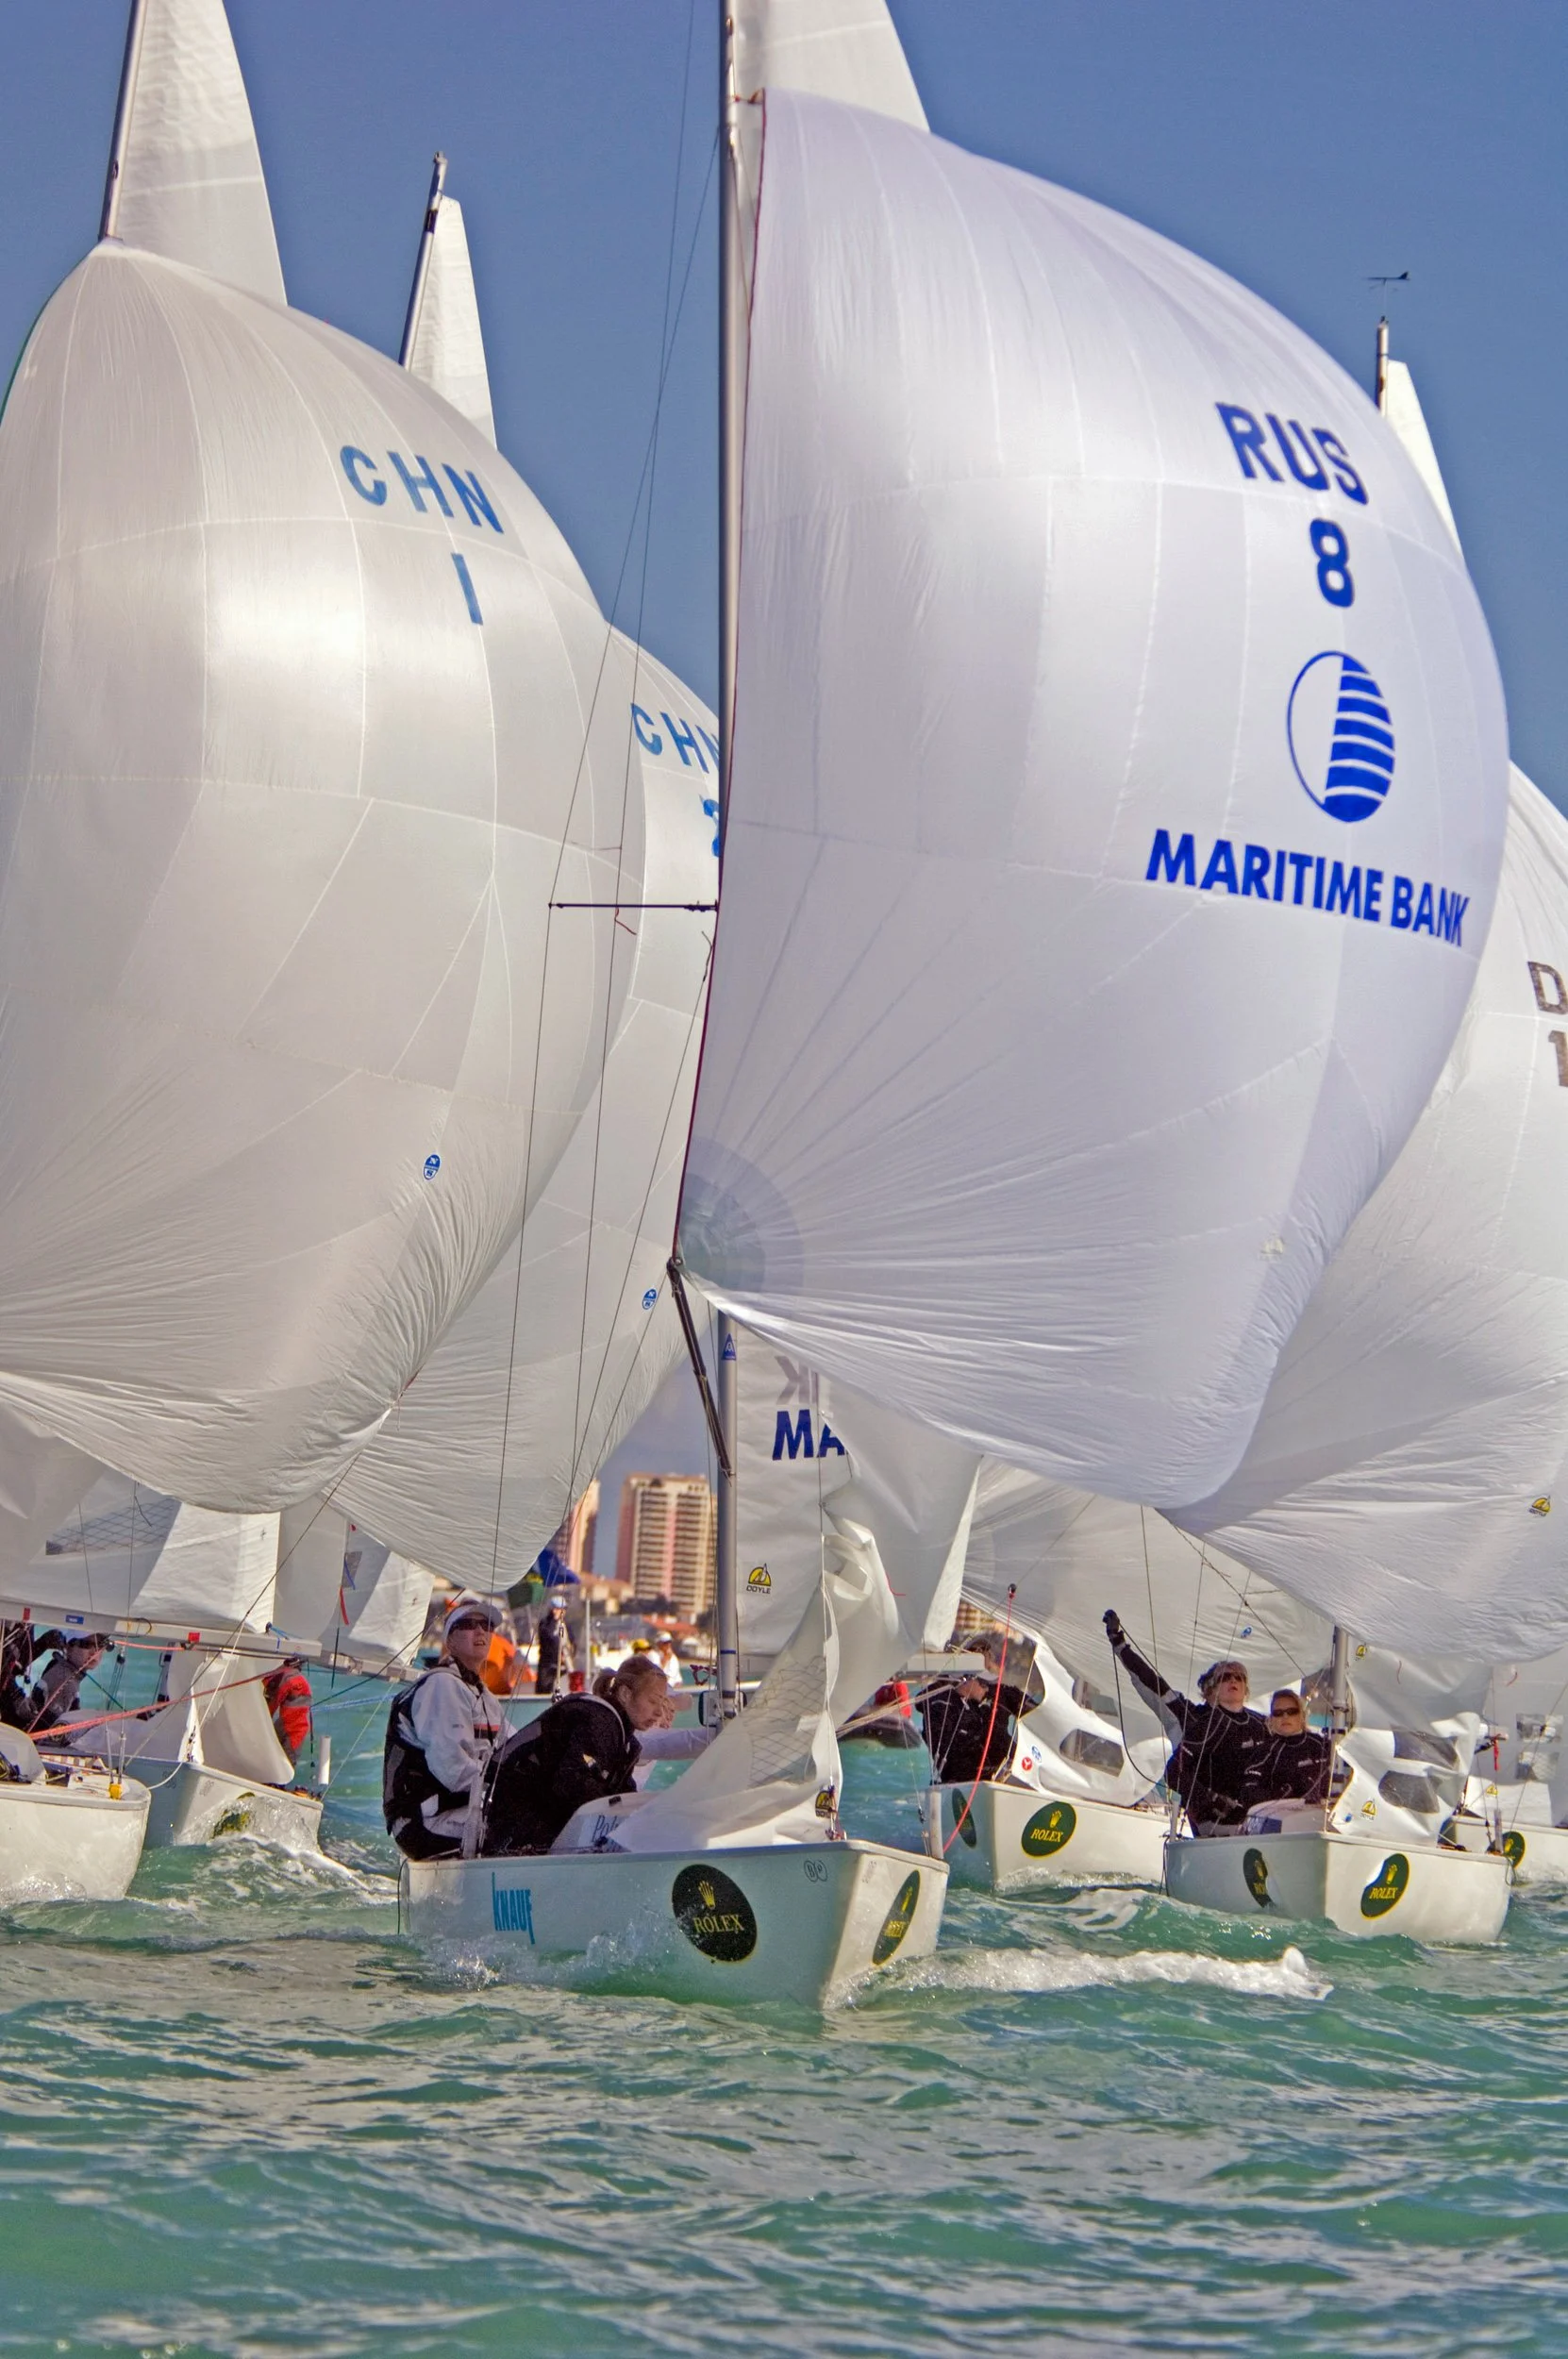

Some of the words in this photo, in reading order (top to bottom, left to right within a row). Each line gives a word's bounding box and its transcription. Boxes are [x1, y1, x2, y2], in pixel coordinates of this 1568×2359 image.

[1215, 403, 1369, 506] RUS
[340, 445, 504, 534] CHN
[1309, 518, 1355, 609] 8
[1145, 828, 1384, 924] MARITIME
[1390, 876, 1470, 947] BANK
[746, 1584, 772, 1595] DOYLE
[1030, 1828, 1063, 1843] ROLEX
[1369, 1886, 1398, 1899] ROLEX
[692, 1914, 744, 1934] ROLEX
